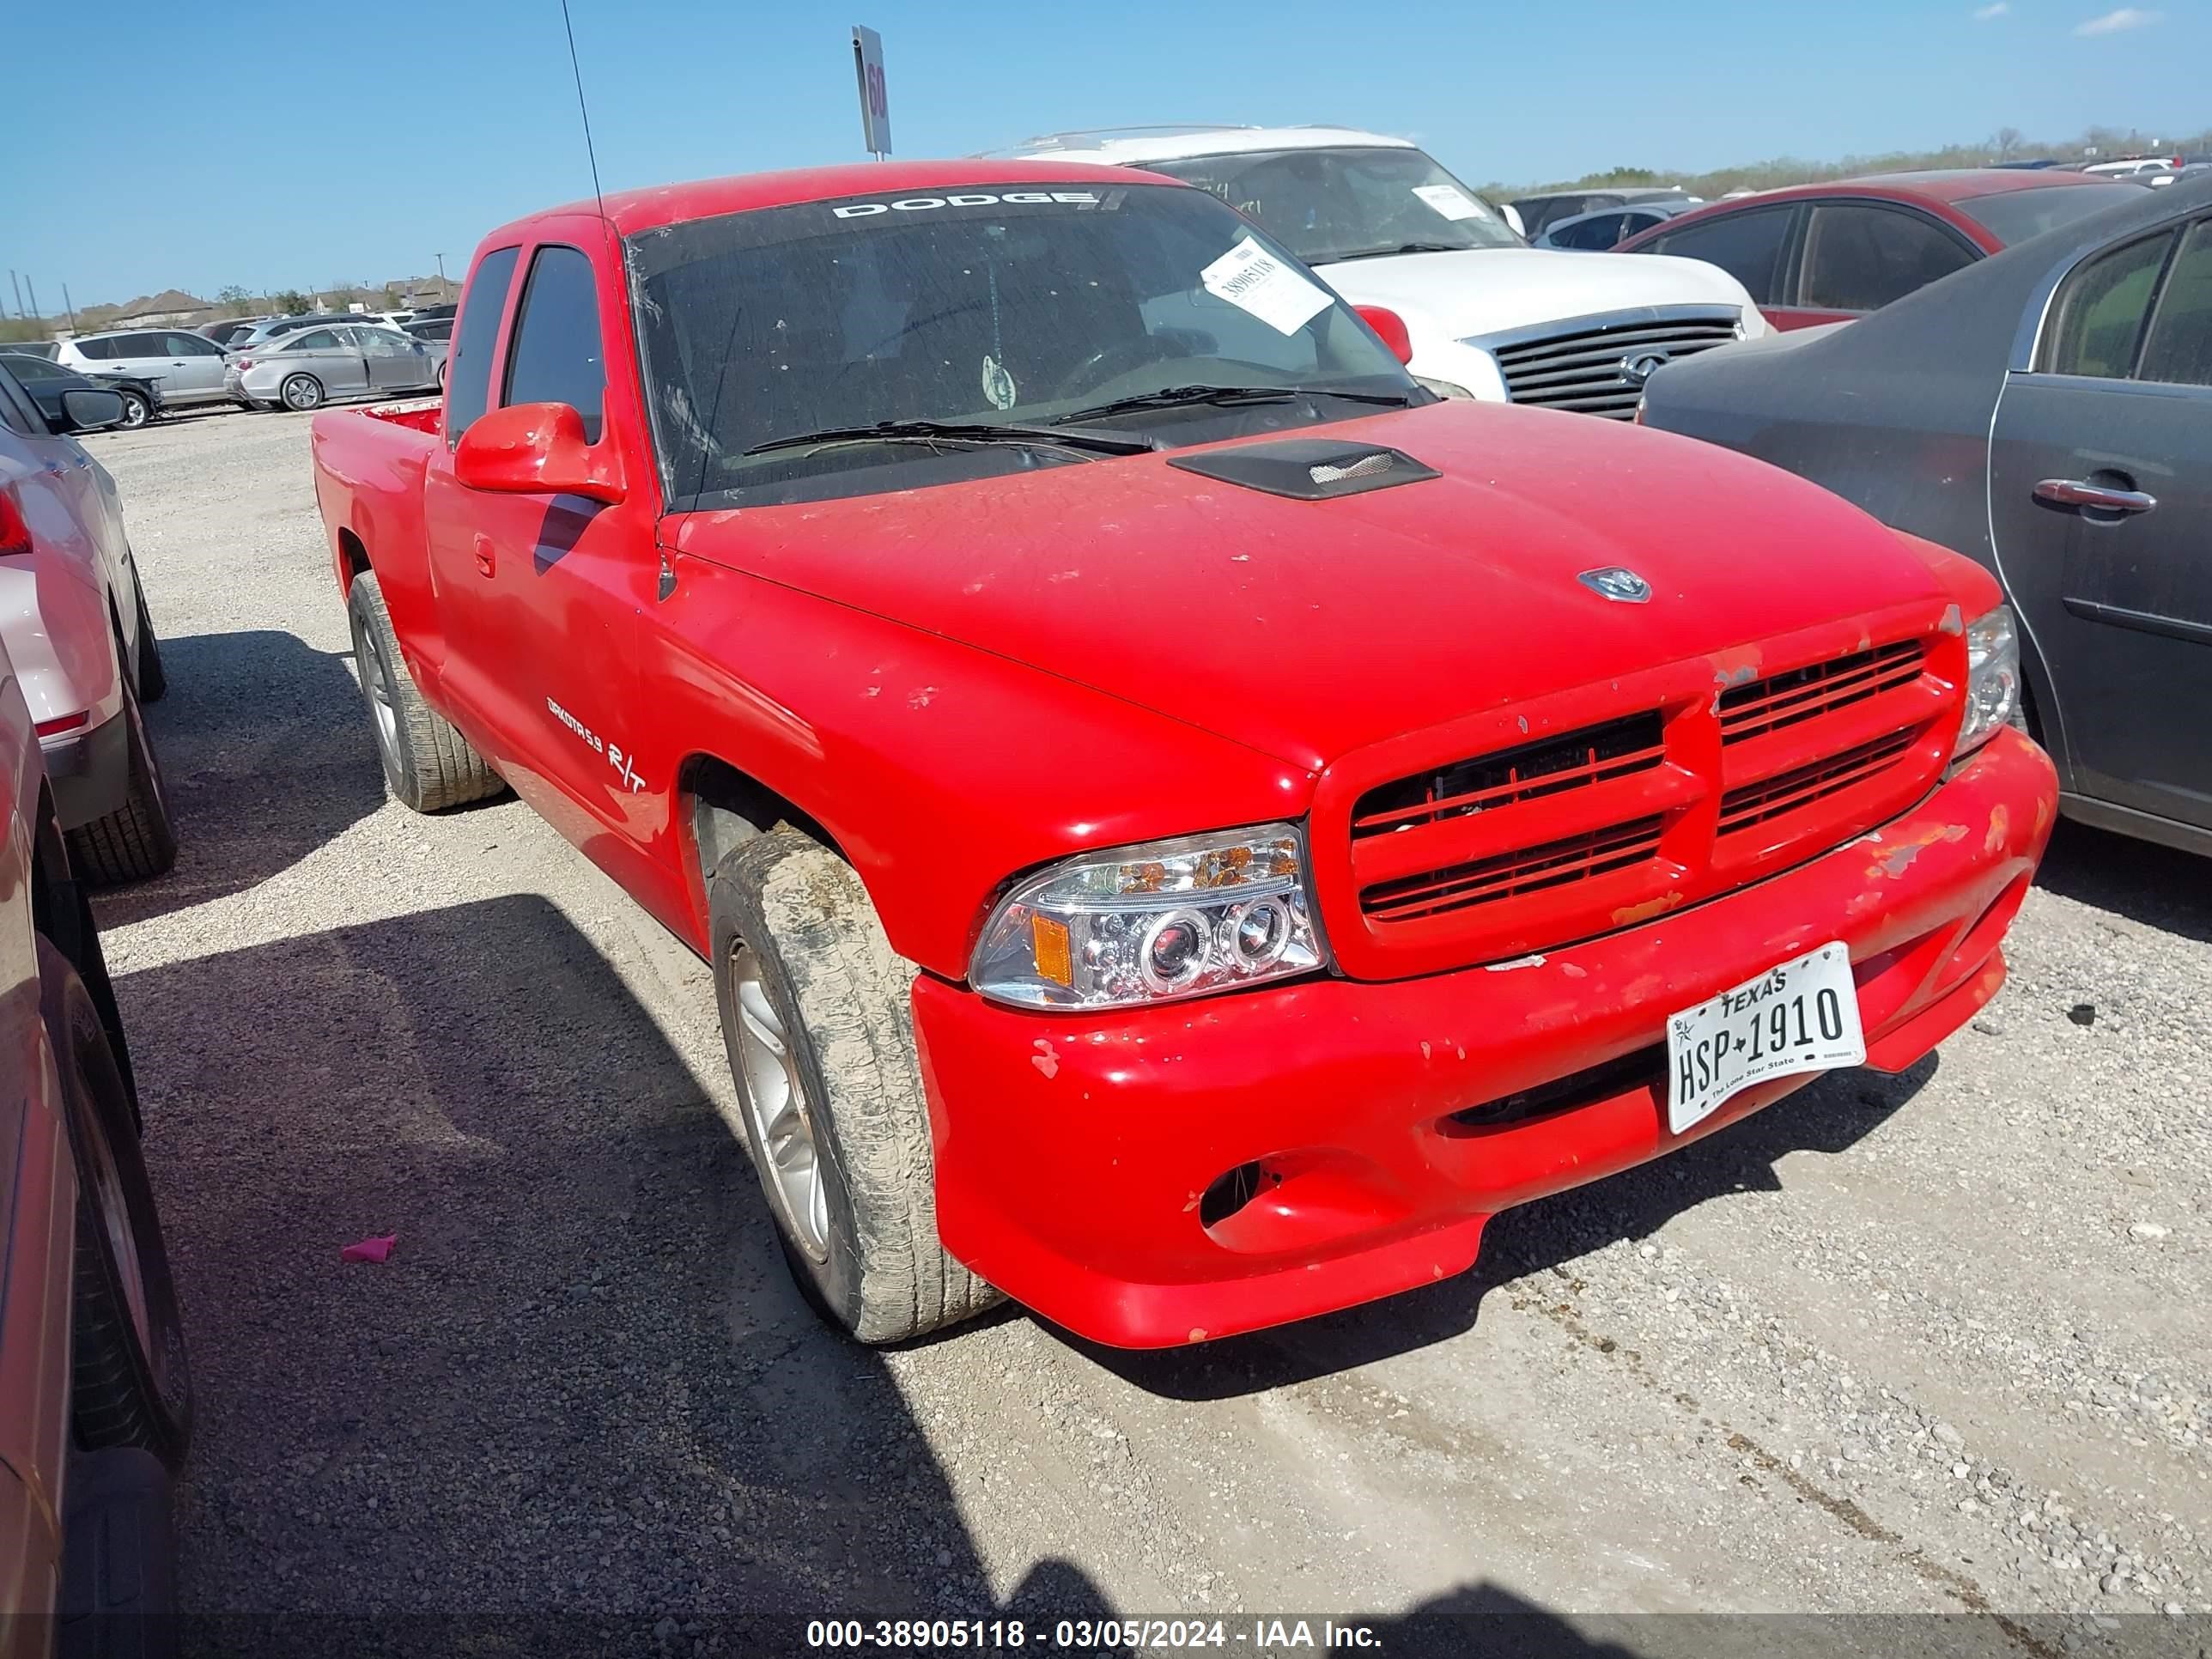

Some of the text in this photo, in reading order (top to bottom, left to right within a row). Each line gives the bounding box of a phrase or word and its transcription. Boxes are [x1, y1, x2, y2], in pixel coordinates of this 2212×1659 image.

[866, 63, 886, 118] 60
[830, 191, 1100, 219] DODGE
[1221, 258, 1277, 299] 38905118
[585, 728, 604, 753] 5.9
[608, 742, 646, 795] R/T
[1722, 972, 1787, 1018] TEXAS
[1679, 988, 1844, 1105] HSP 1910
[1712, 1057, 1795, 1098] The Lone Star State
